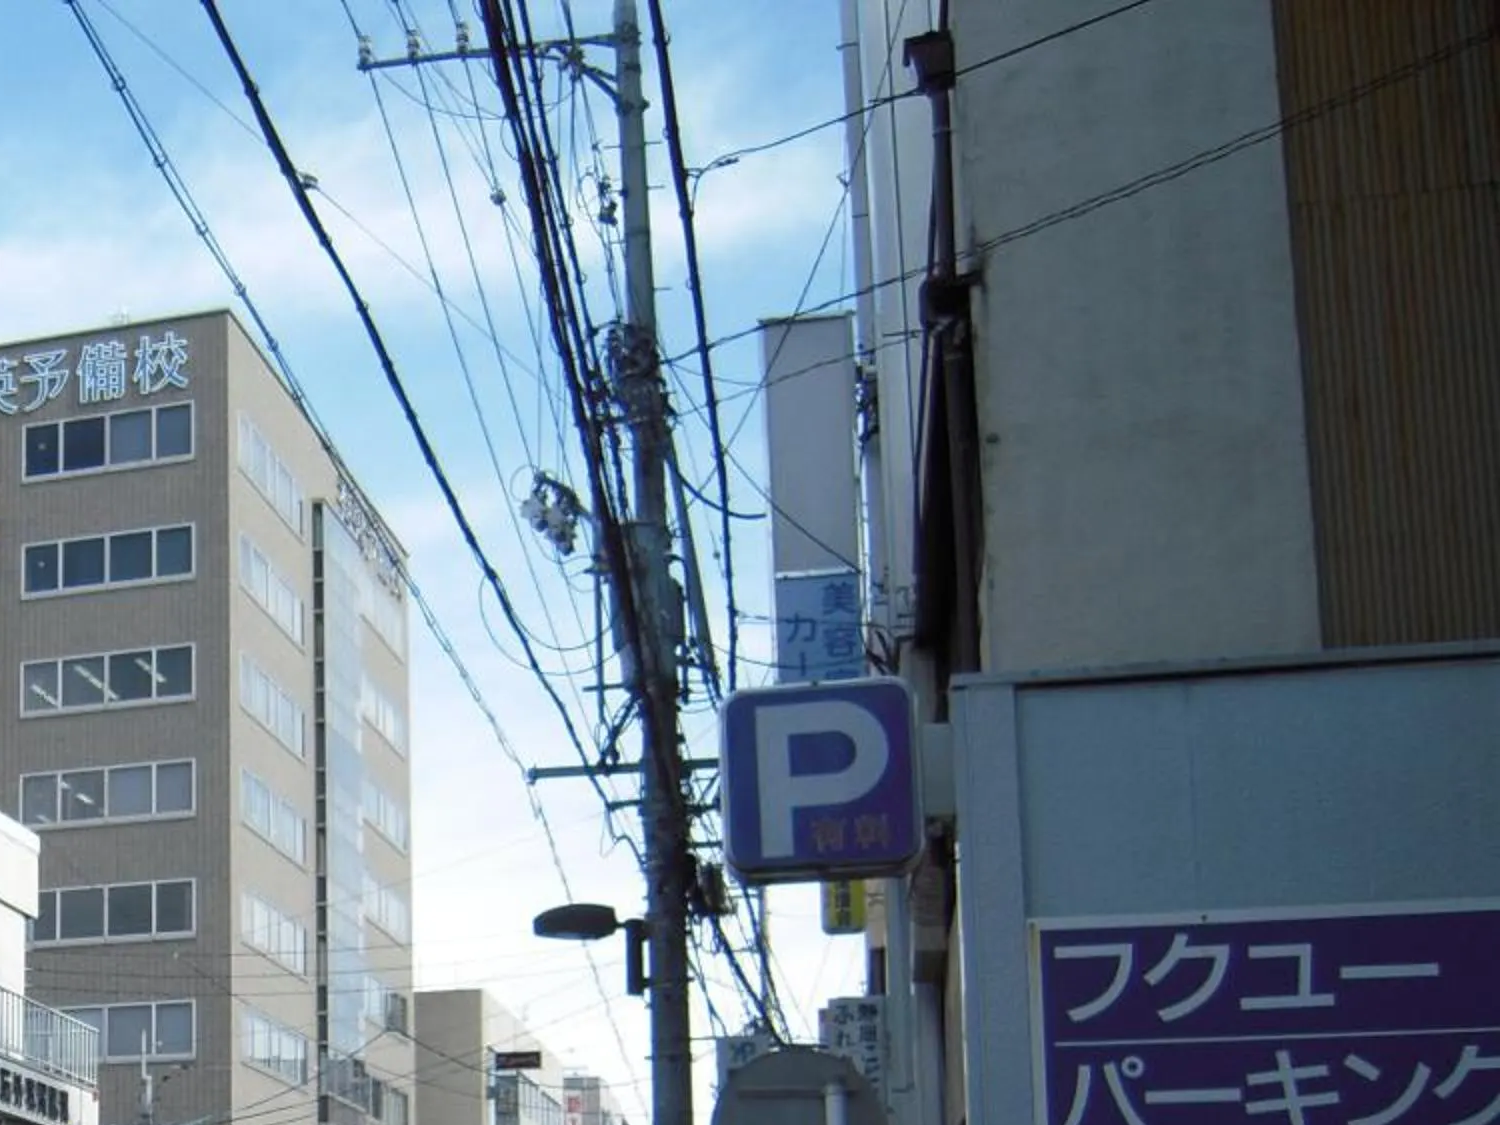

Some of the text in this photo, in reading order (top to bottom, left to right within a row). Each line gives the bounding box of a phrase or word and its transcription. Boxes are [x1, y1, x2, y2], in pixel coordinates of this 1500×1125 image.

[754, 699, 889, 858] P
[1053, 932, 1441, 1024] フクユー
